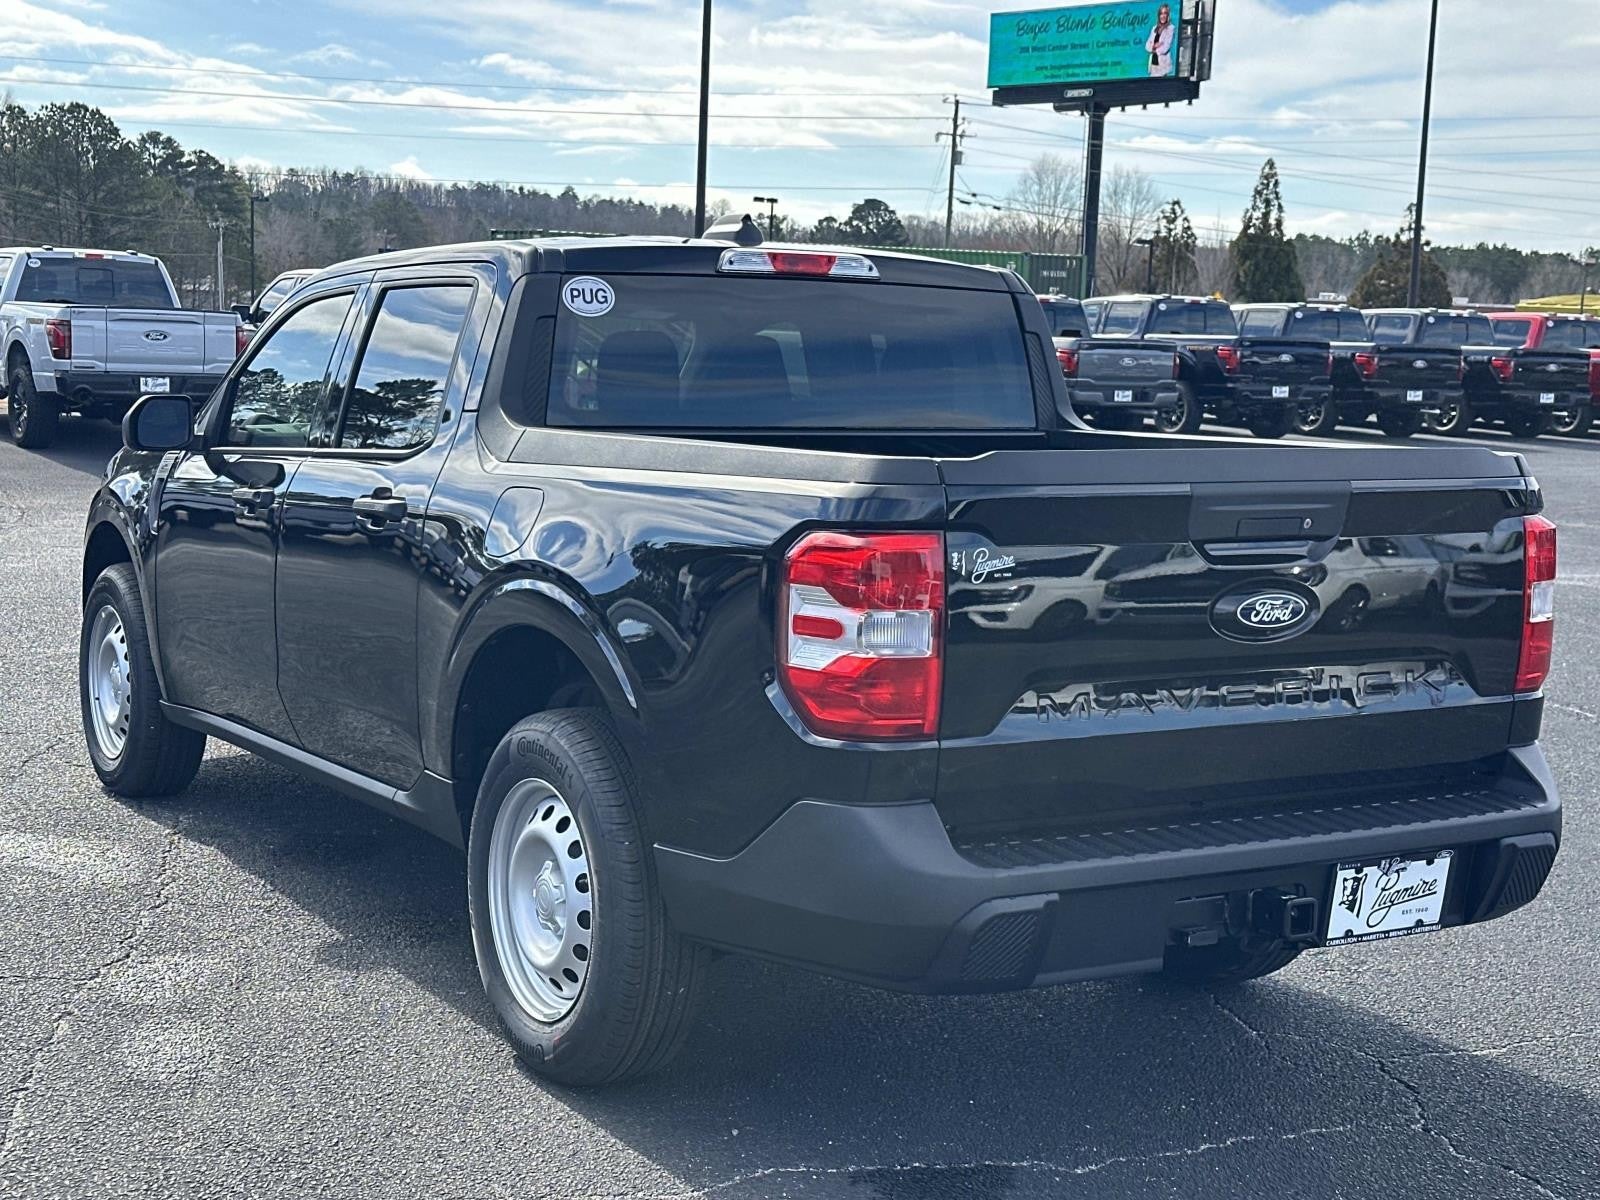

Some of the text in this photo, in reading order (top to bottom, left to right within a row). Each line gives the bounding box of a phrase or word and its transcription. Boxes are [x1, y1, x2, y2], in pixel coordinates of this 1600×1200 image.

[1056, 13, 1095, 33] Blonde
[1101, 10, 1150, 34] Boutique
[570, 288, 608, 304] PUG
[971, 548, 1016, 584] Pugmire
[1251, 600, 1293, 622] Ford
[1036, 667, 1446, 722] MAVERICK
[517, 736, 568, 779] Continental
[1367, 871, 1438, 928] Pugmire
